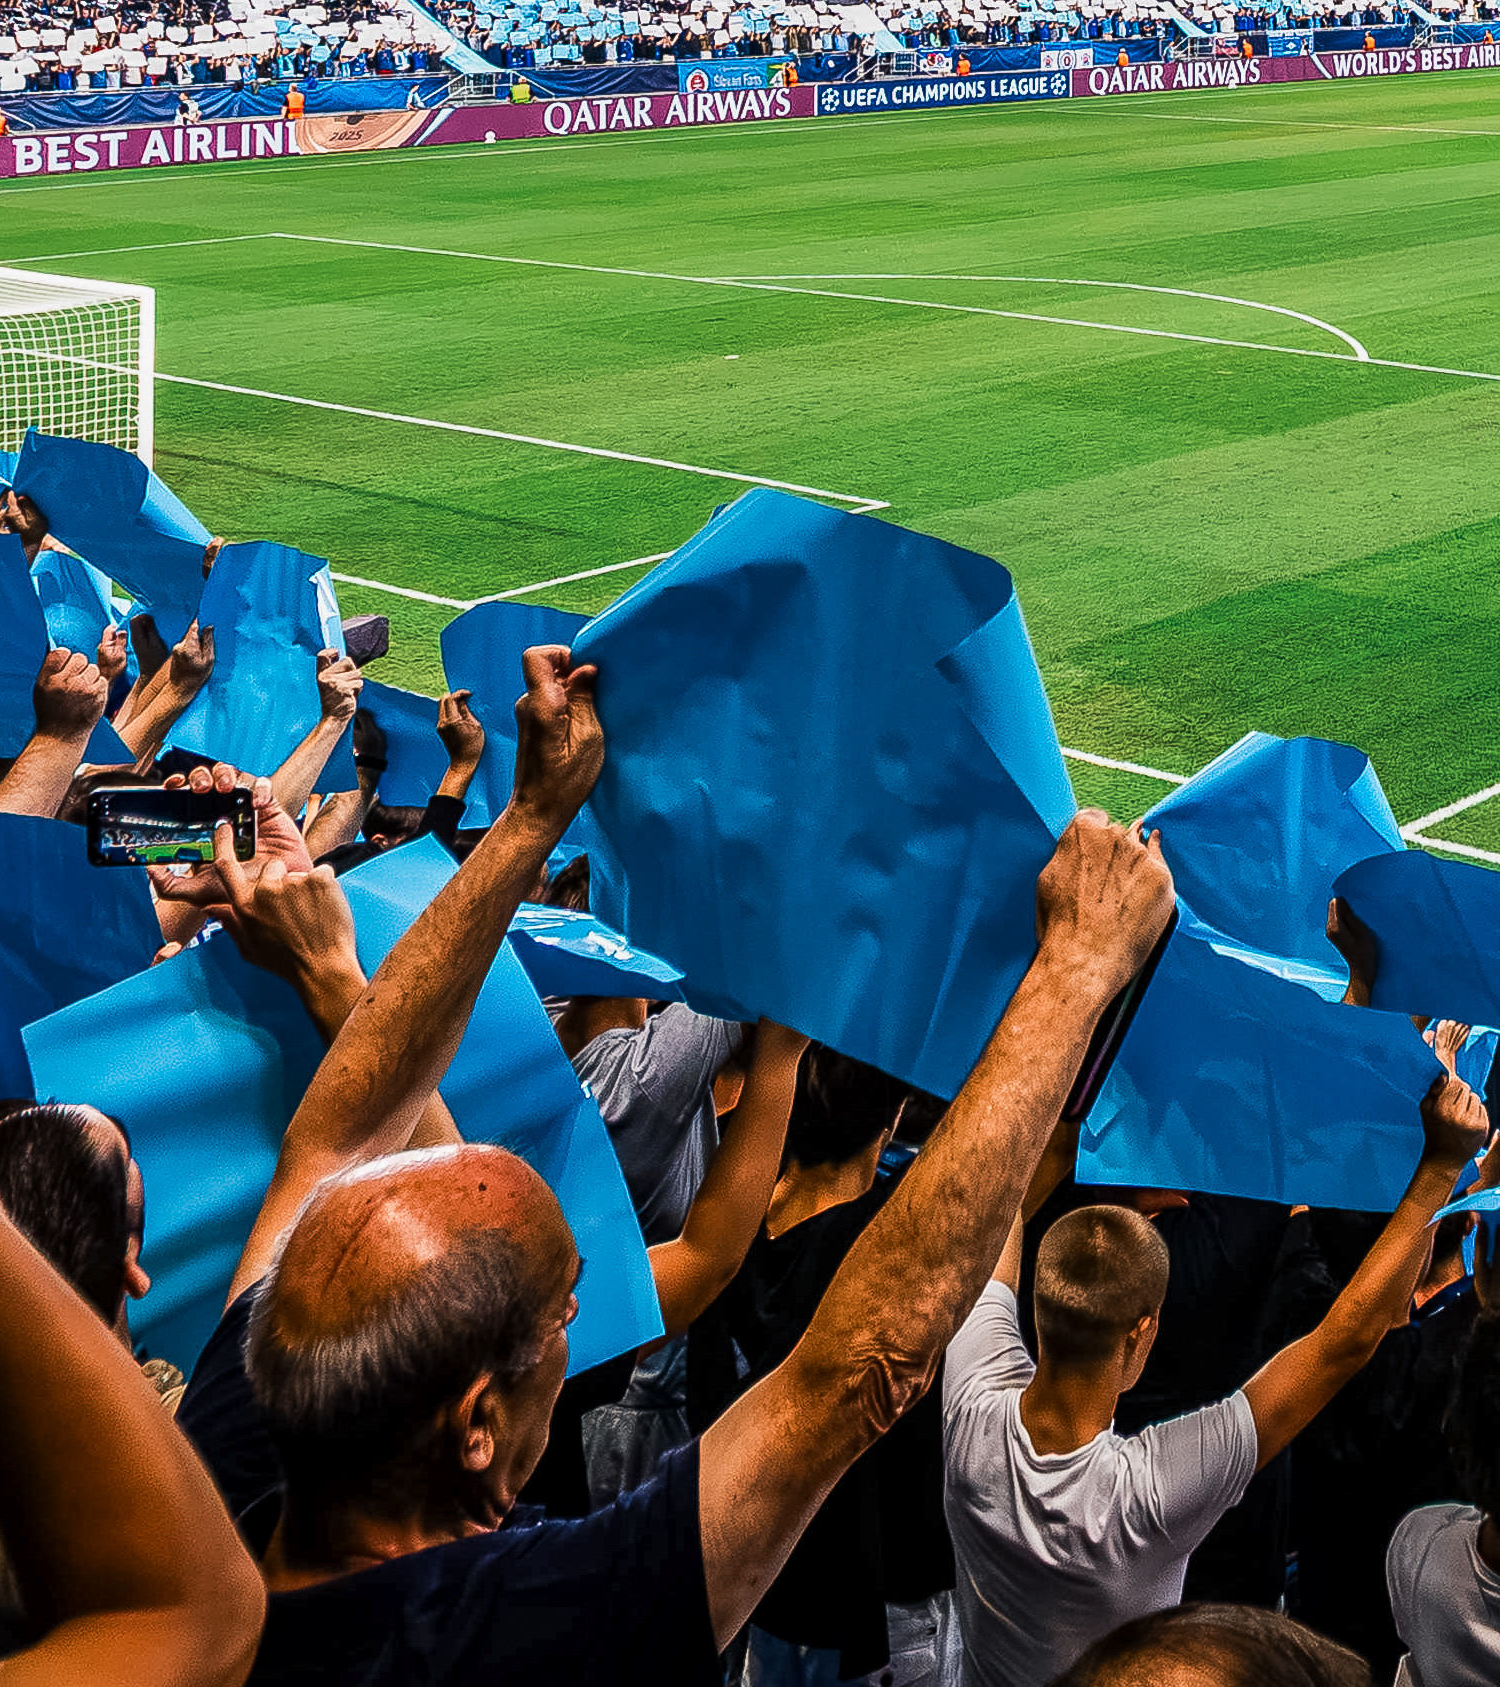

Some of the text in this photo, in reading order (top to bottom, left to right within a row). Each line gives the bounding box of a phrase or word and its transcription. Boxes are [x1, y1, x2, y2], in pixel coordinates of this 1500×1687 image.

[1088, 58, 1260, 95] QATAR AIRWAYS
[1332, 51, 1416, 78] WORLD'S
[1419, 47, 1463, 70] BEST
[843, 76, 1048, 107] UEFA CHAMPIONS LEAGUE
[543, 88, 791, 135] QATAR AIRWAYS
[329, 129, 363, 143] 2025
[13, 132, 127, 175] BEST
